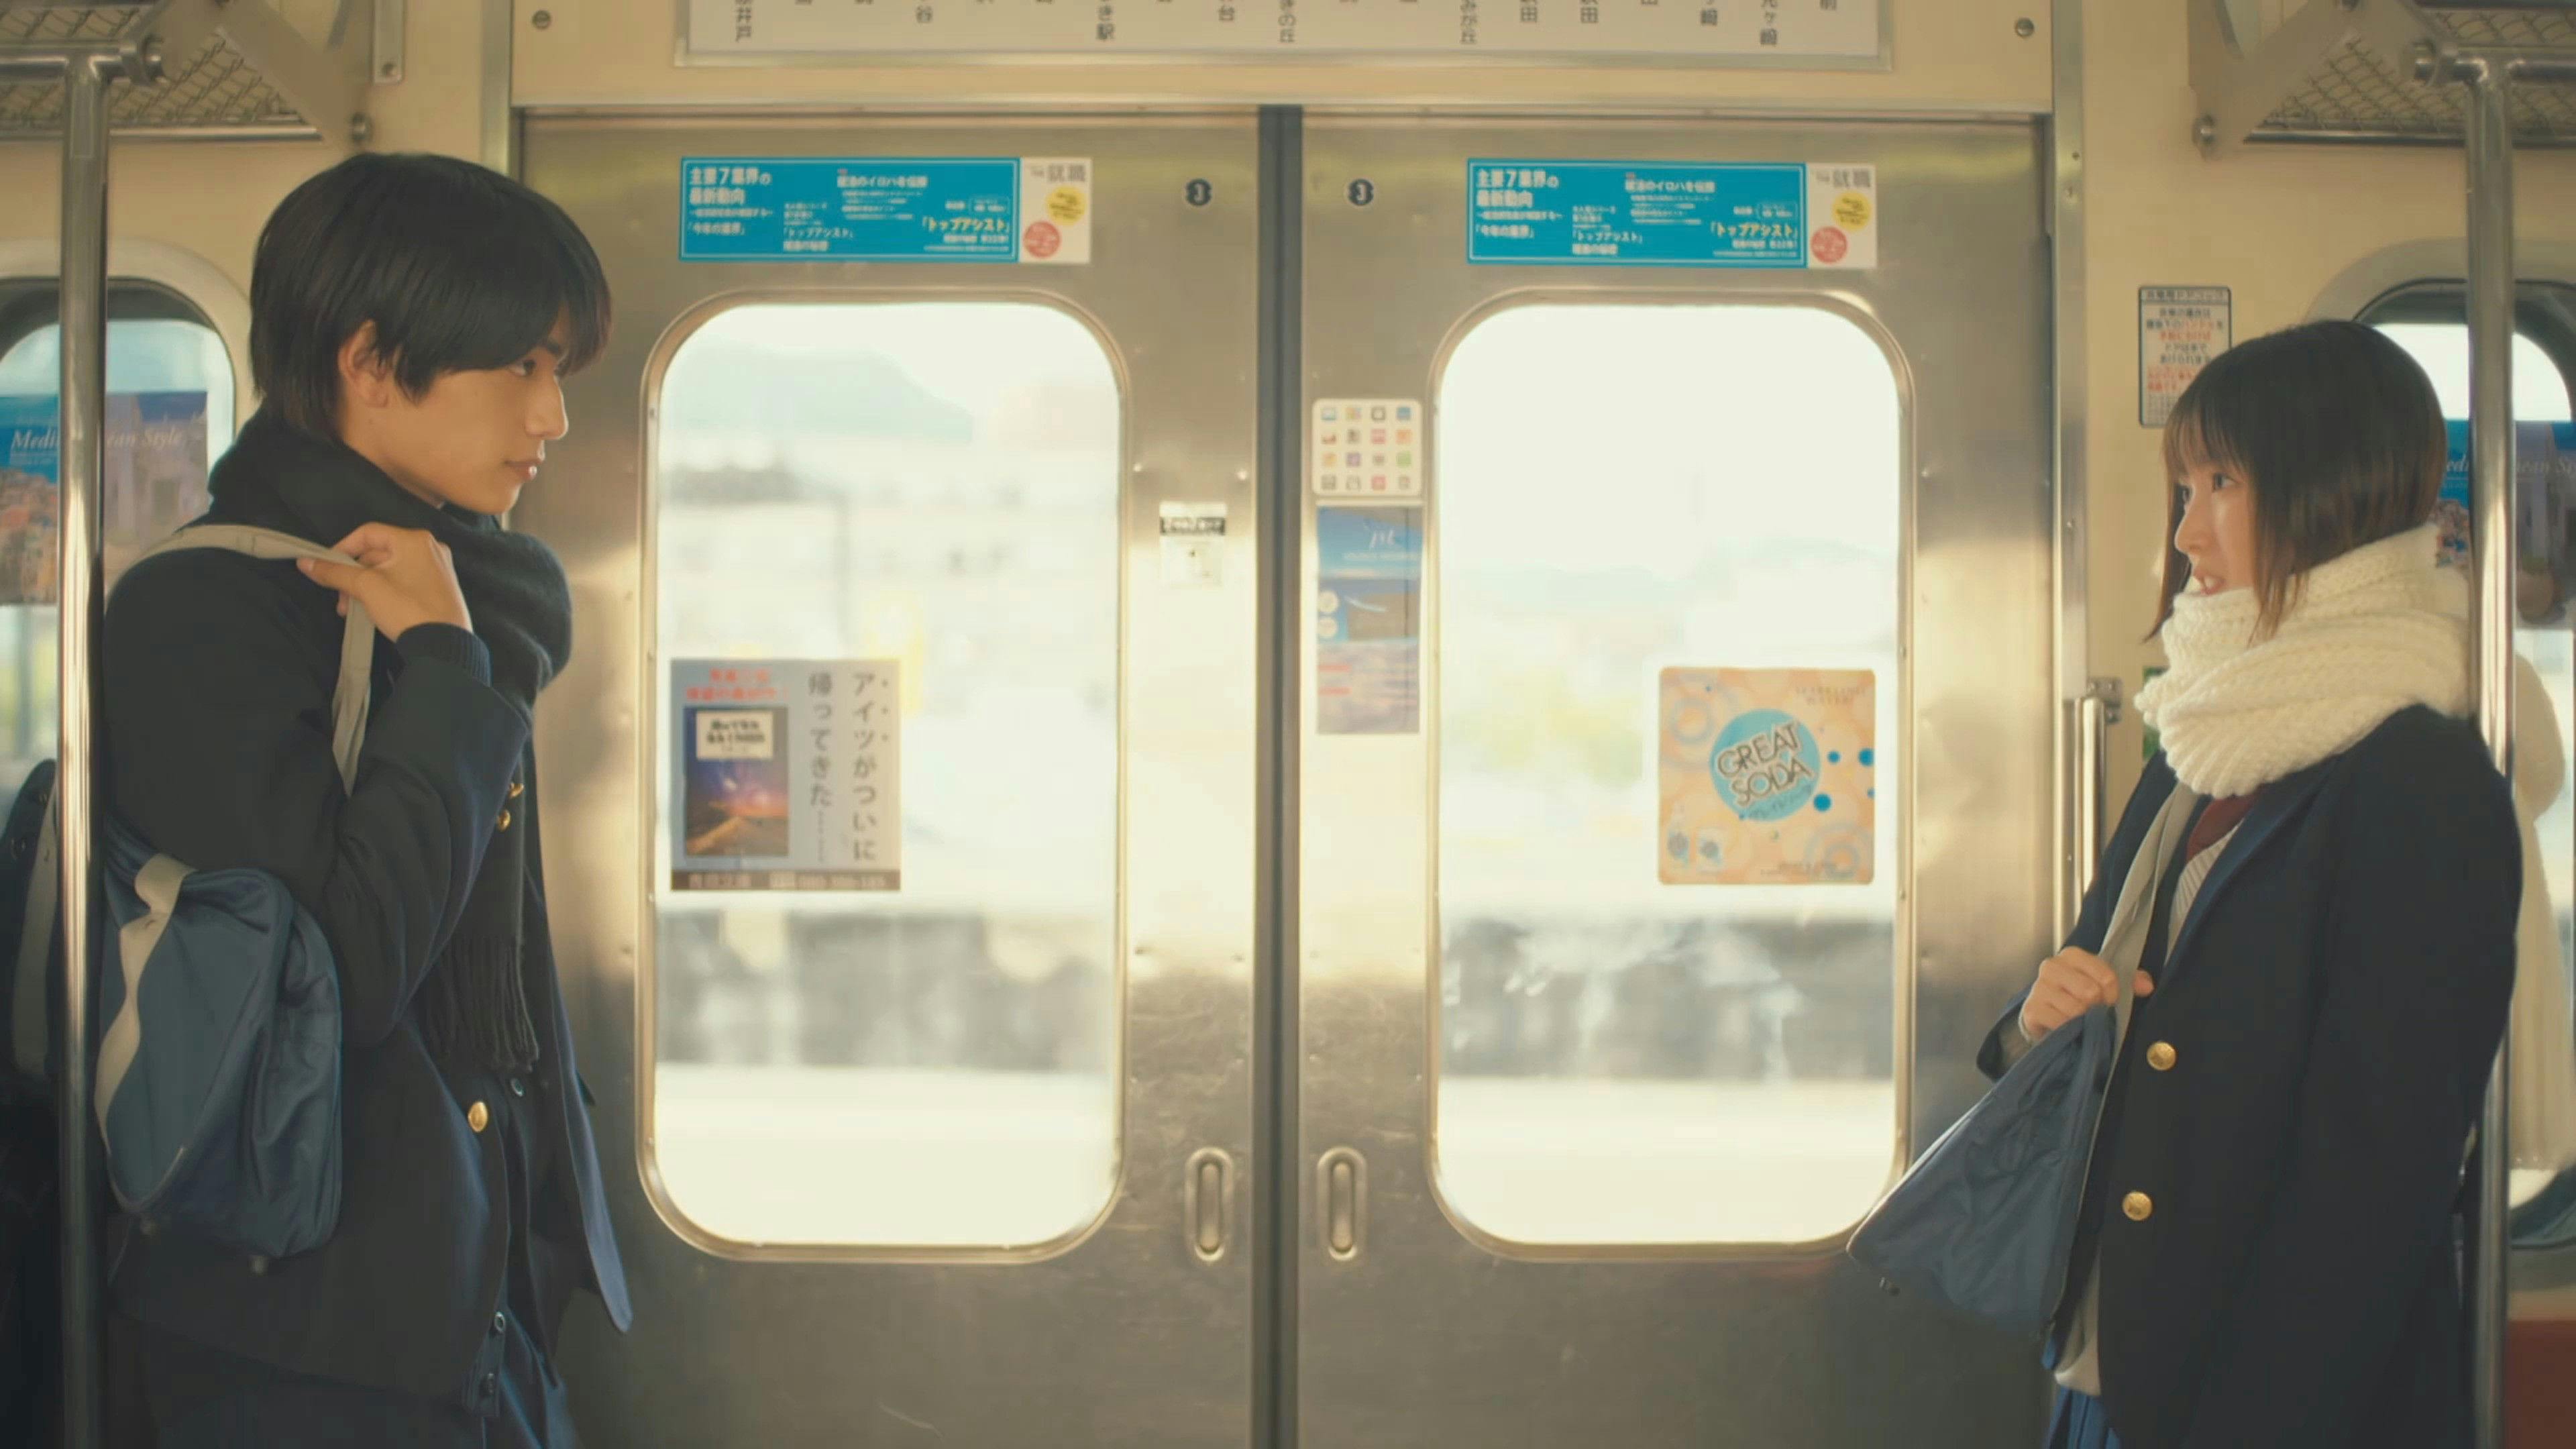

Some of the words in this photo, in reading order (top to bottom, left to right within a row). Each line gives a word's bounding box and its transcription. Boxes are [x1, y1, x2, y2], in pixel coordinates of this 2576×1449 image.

[853, 672, 877, 861] アイツがついに
[1717, 720, 1800, 777] GREAT
[1731, 757, 1815, 807] SODA
